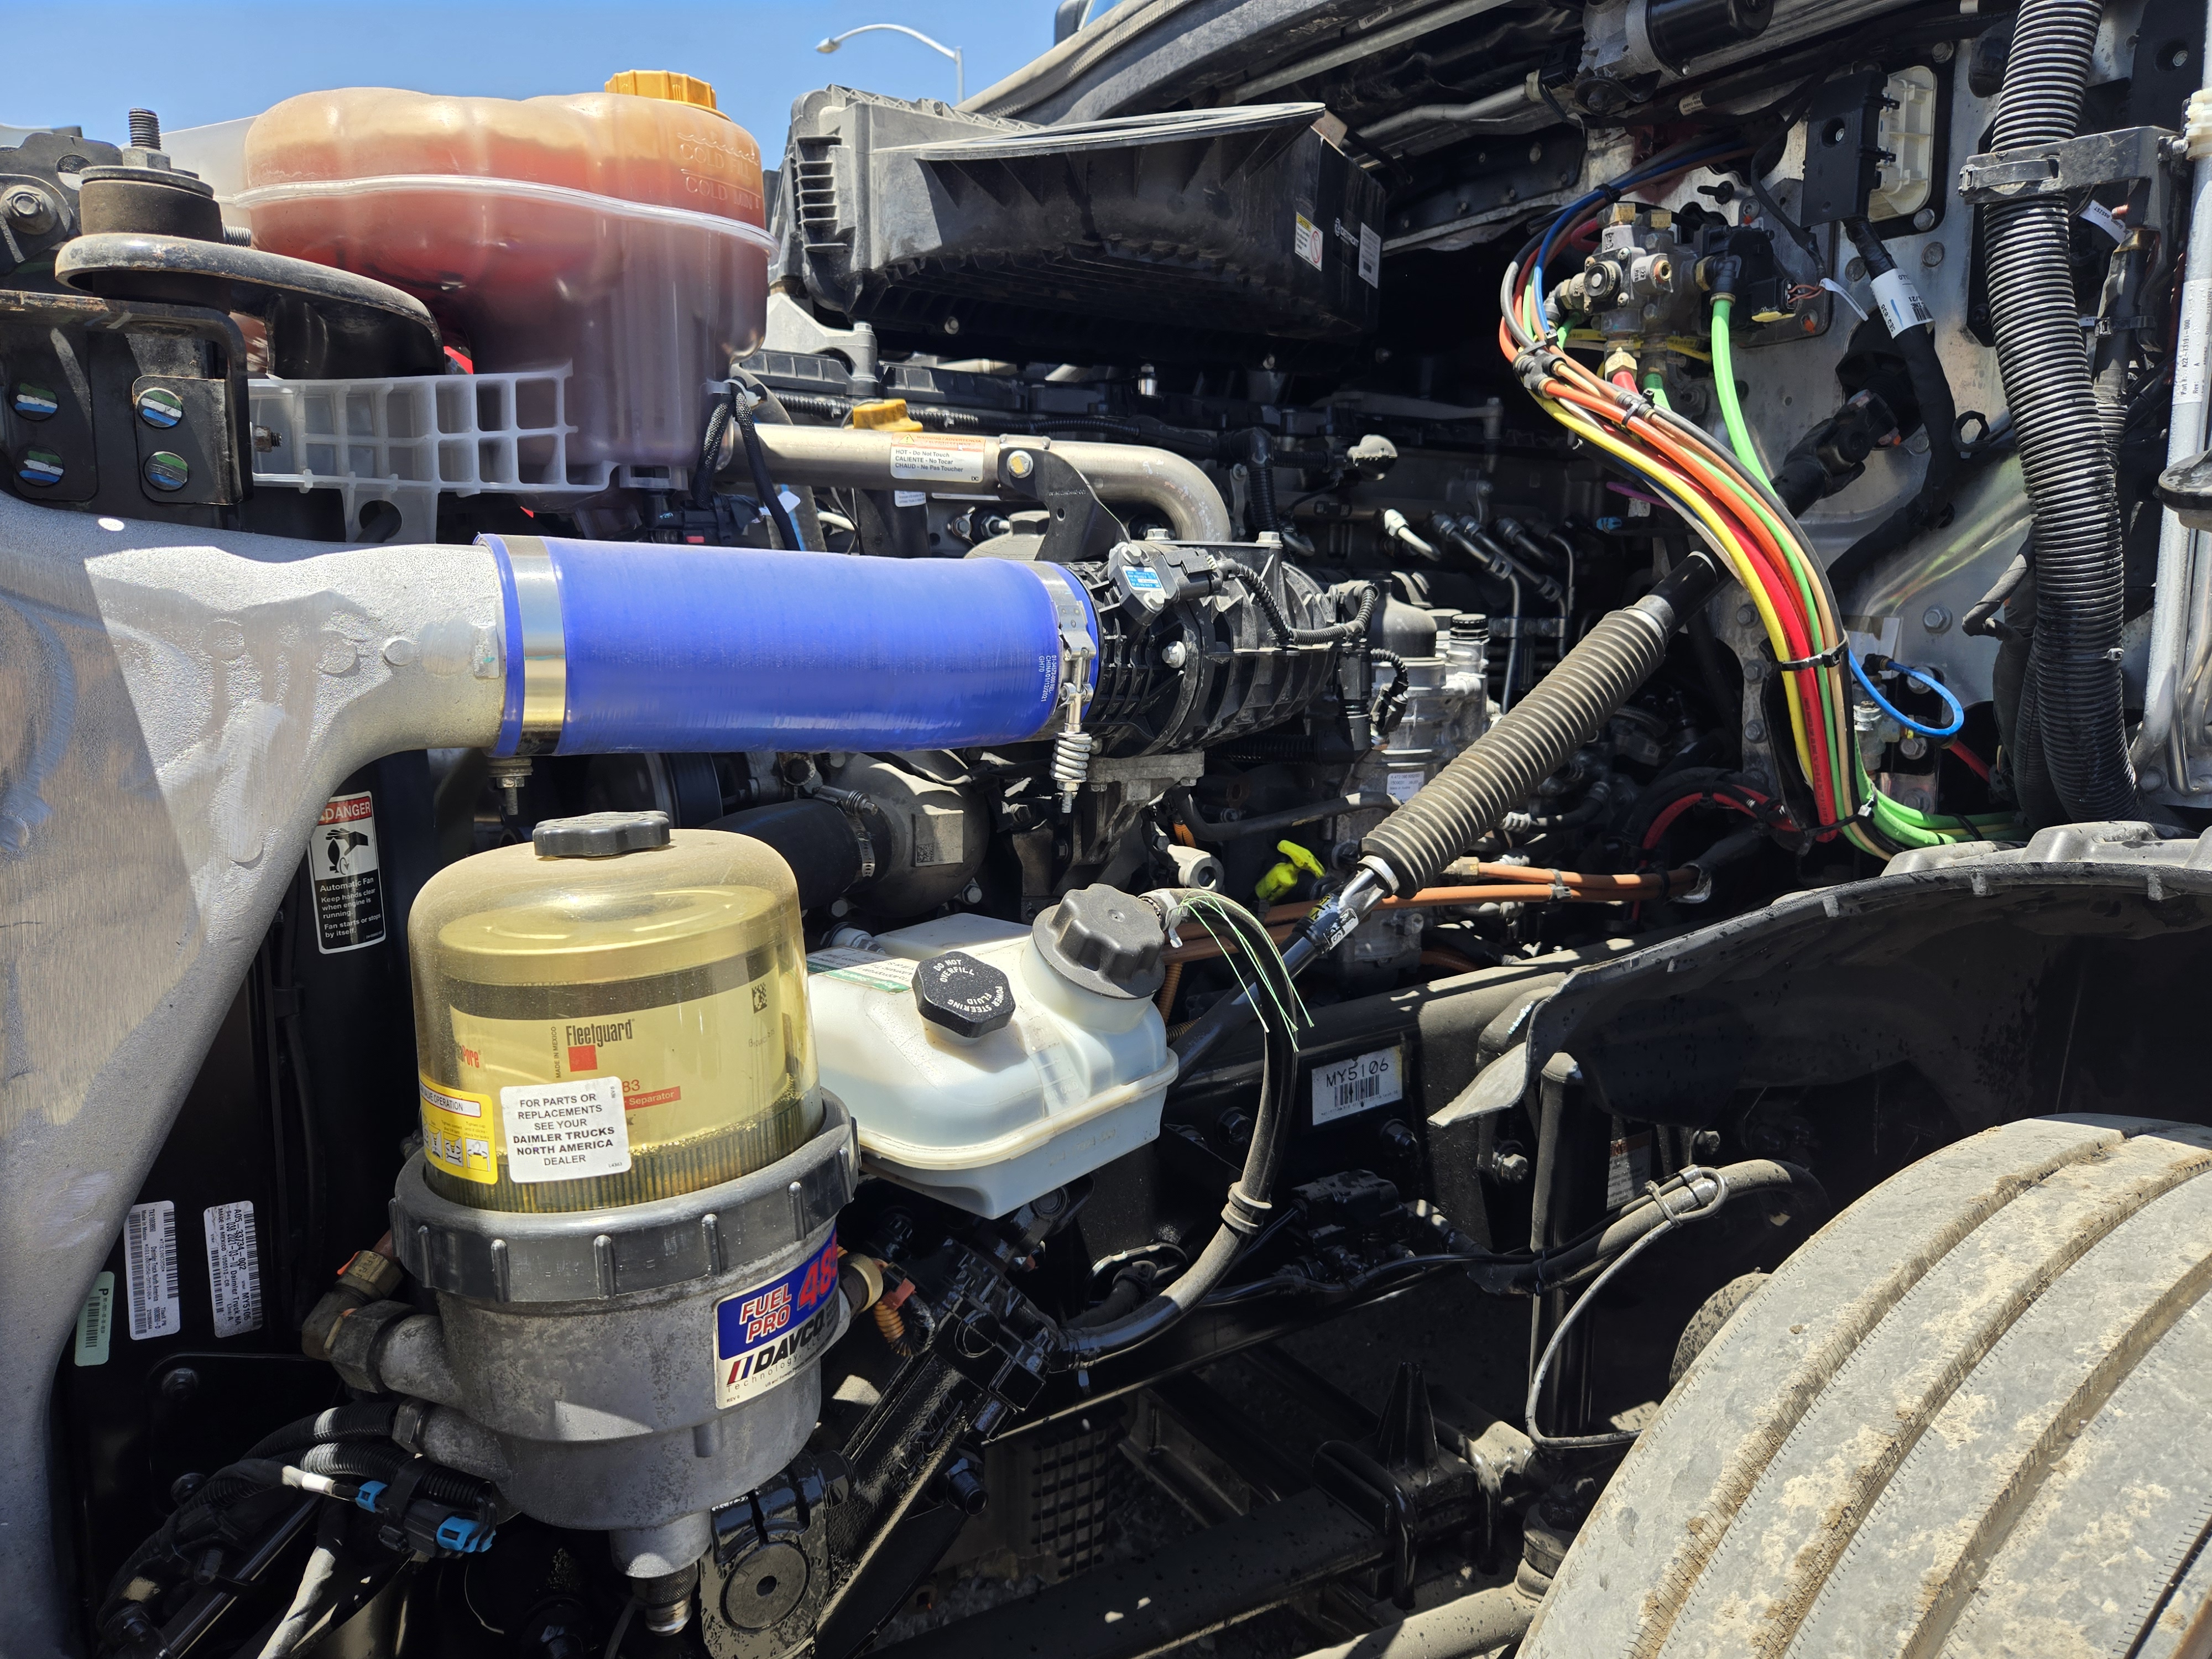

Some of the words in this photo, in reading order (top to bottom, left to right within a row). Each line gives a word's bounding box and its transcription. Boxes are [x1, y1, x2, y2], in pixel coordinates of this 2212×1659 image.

[680, 143, 724, 169] COLD
[686, 176, 728, 201] COLD
[325, 801, 371, 821] DANGER
[320, 879, 362, 892] Automatic
[342, 892, 362, 900] hands
[343, 900, 365, 908] engine
[323, 910, 353, 919] running.
[336, 927, 356, 936] itself.
[340, 919, 360, 928] starts
[933, 962, 945, 972] DO
[940, 966, 975, 983] OVERFILL
[873, 979, 899, 989] Power
[967, 992, 992, 1005] FLUID
[991, 985, 1004, 1007] POWER
[947, 999, 992, 1013] STEERING
[551, 1026, 559, 1051] MEXICO
[566, 1019, 633, 1047] Fleetguard
[1326, 1057, 1389, 1088] MY5106
[434, 1095, 463, 1112] OPERATION
[520, 1099, 541, 1108] FOR
[542, 1095, 577, 1107] PARTS
[581, 1093, 597, 1102] OR
[629, 1091, 674, 1105] Separator
[518, 1104, 603, 1120] REPLACEMENTS
[534, 1121, 555, 1131] SEE
[557, 1118, 588, 1129] YOUR
[513, 1133, 563, 1144] DAIMLER
[565, 1126, 615, 1140] TRUCKS
[517, 1145, 555, 1156] NORTH
[559, 1139, 614, 1152] AMERICA
[544, 1154, 587, 1166] DEALER
[227, 1222, 237, 1232] 038
[227, 1233, 239, 1267] 2021-03-10
[234, 1209, 247, 1271] A05-33734-002
[242, 1292, 251, 1321] MY5106
[739, 1282, 792, 1326] FUEL
[234, 1314, 242, 1326] NA
[745, 1304, 791, 1344] PRO
[753, 1308, 825, 1375] DAVCO
